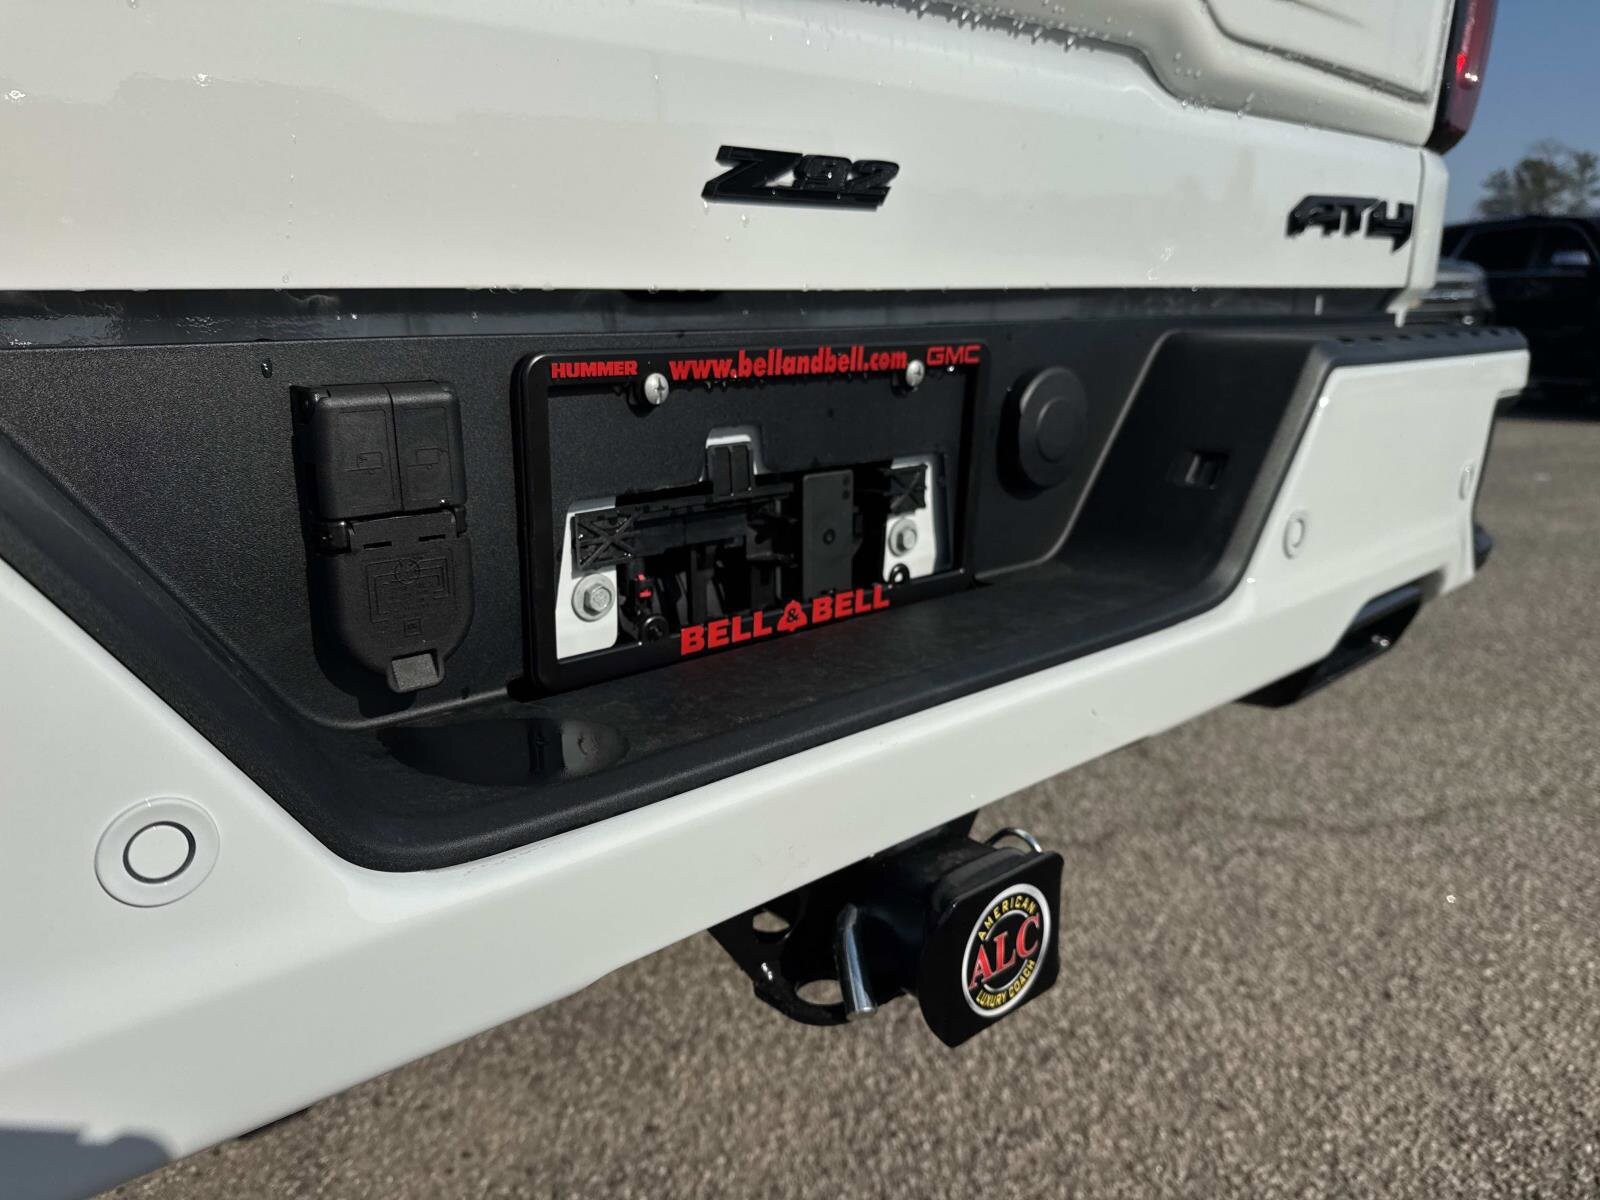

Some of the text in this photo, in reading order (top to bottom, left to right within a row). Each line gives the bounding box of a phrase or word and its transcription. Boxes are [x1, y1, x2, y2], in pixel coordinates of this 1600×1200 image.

[1286, 195, 1414, 252] AT4
[551, 360, 638, 379] HUMMER
[668, 345, 908, 380] www.bellandbell.com
[926, 345, 981, 366] GMC
[680, 611, 772, 656] BELL
[812, 585, 890, 624] BELL
[978, 895, 1036, 941] AMERICAN
[968, 913, 1040, 990] ALC
[976, 959, 1036, 1008] LUXURY COACH
